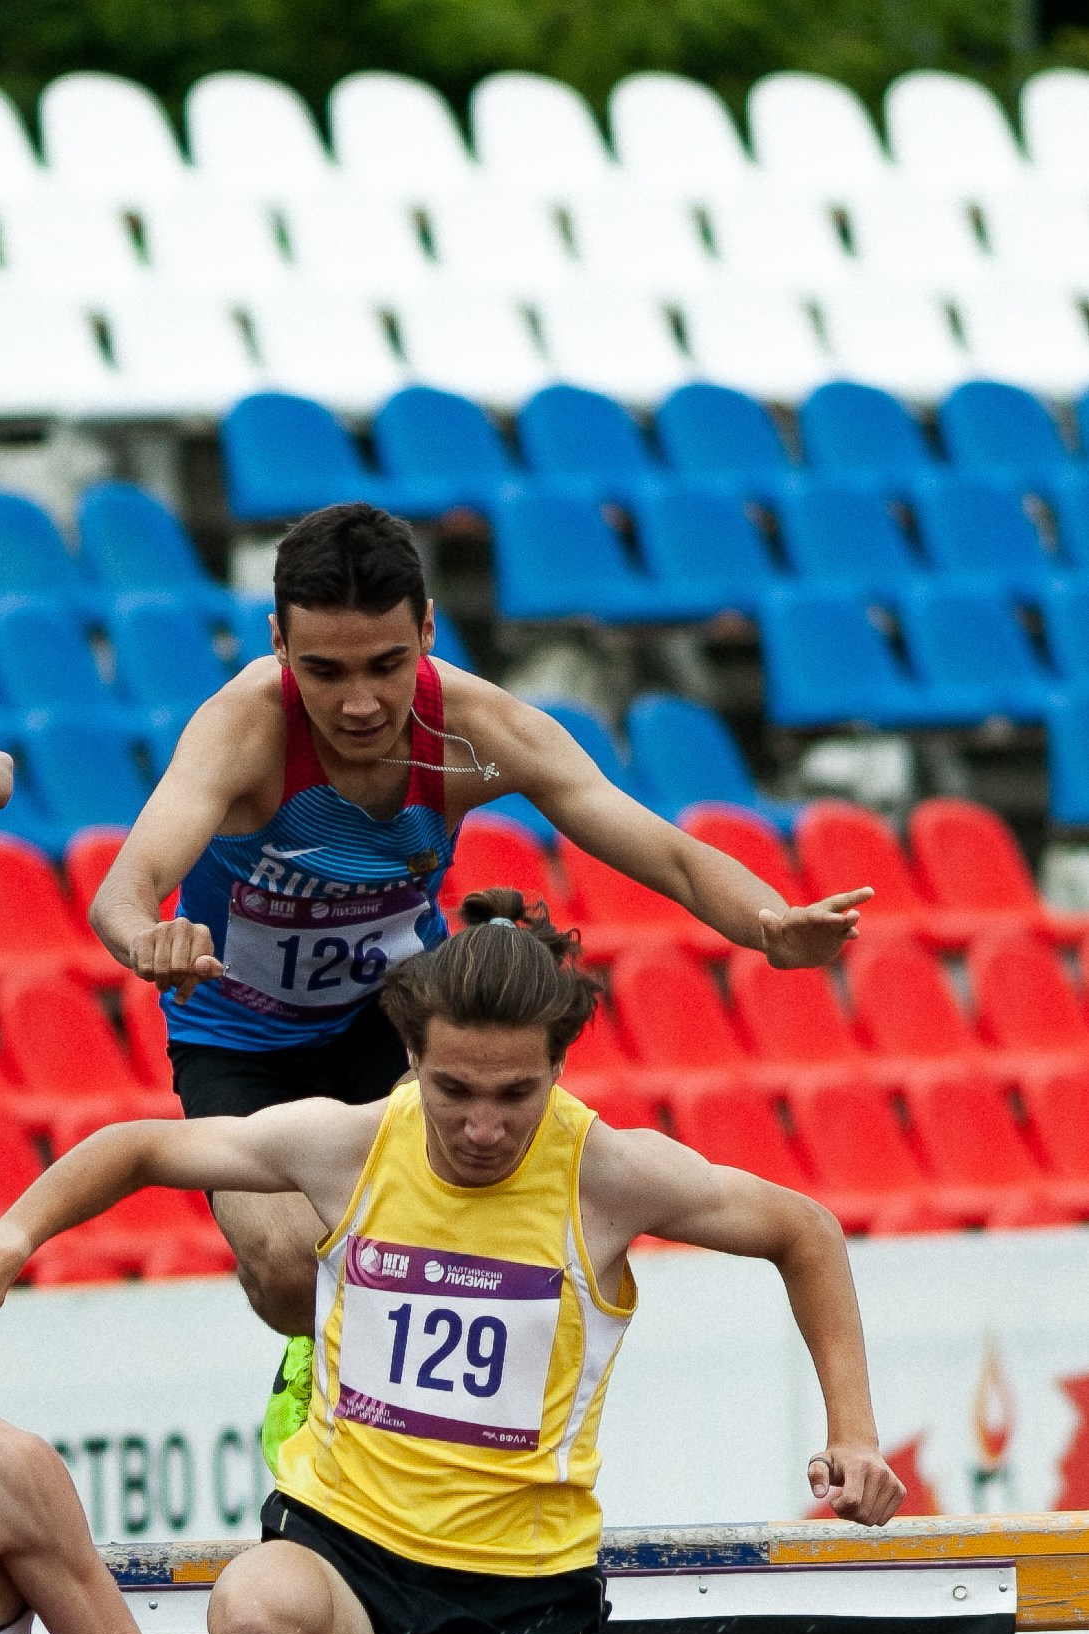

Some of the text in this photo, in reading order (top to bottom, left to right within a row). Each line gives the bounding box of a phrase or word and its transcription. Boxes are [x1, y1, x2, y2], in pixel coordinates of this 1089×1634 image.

[331, 902, 383, 917] ЛИЗИНГ
[276, 930, 388, 991] 126
[382, 1251, 410, 1272] НГК
[447, 1264, 503, 1280] БАЛТИЙСКИЙ
[444, 1273, 503, 1291] ЛИЗИНГ
[388, 1303, 508, 1398] 129
[499, 1432, 527, 1444] ВФЛА
